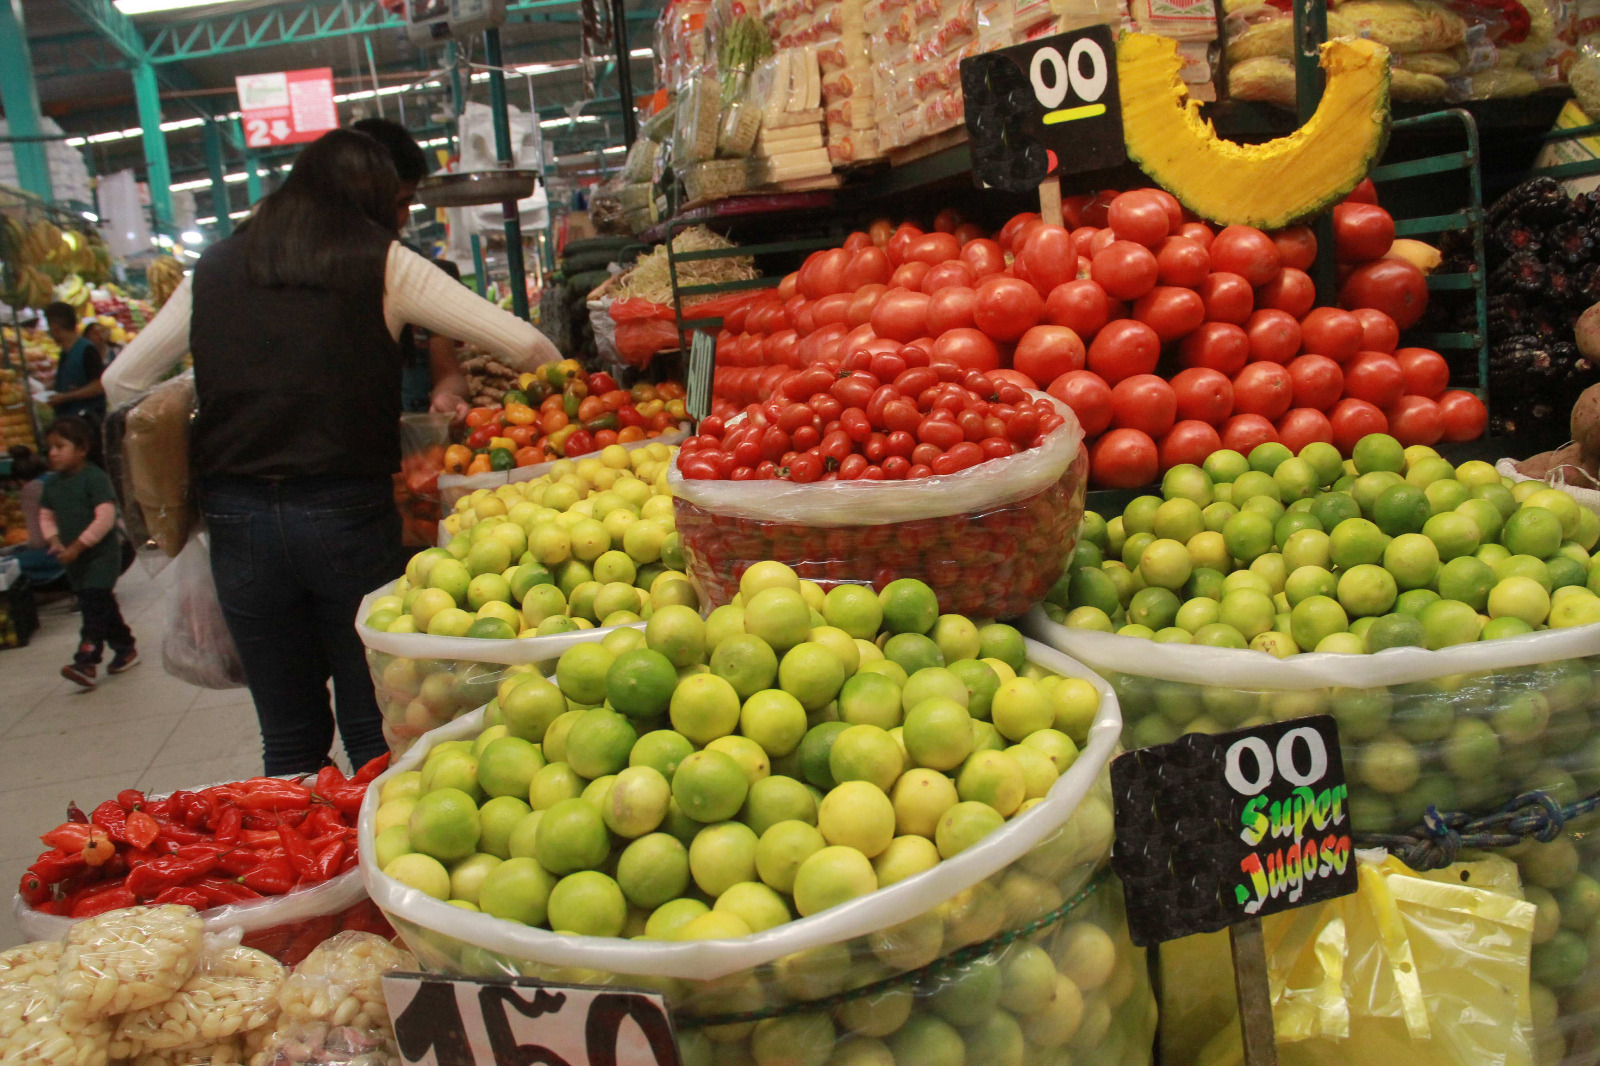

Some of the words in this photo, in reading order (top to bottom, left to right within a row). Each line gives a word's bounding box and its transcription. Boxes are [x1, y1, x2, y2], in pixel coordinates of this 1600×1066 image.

[1030, 38, 1107, 108] 00
[247, 120, 271, 146] 2
[1225, 726, 1328, 796] 00
[1240, 785, 1348, 846] Super
[1235, 834, 1350, 915] Jugoso
